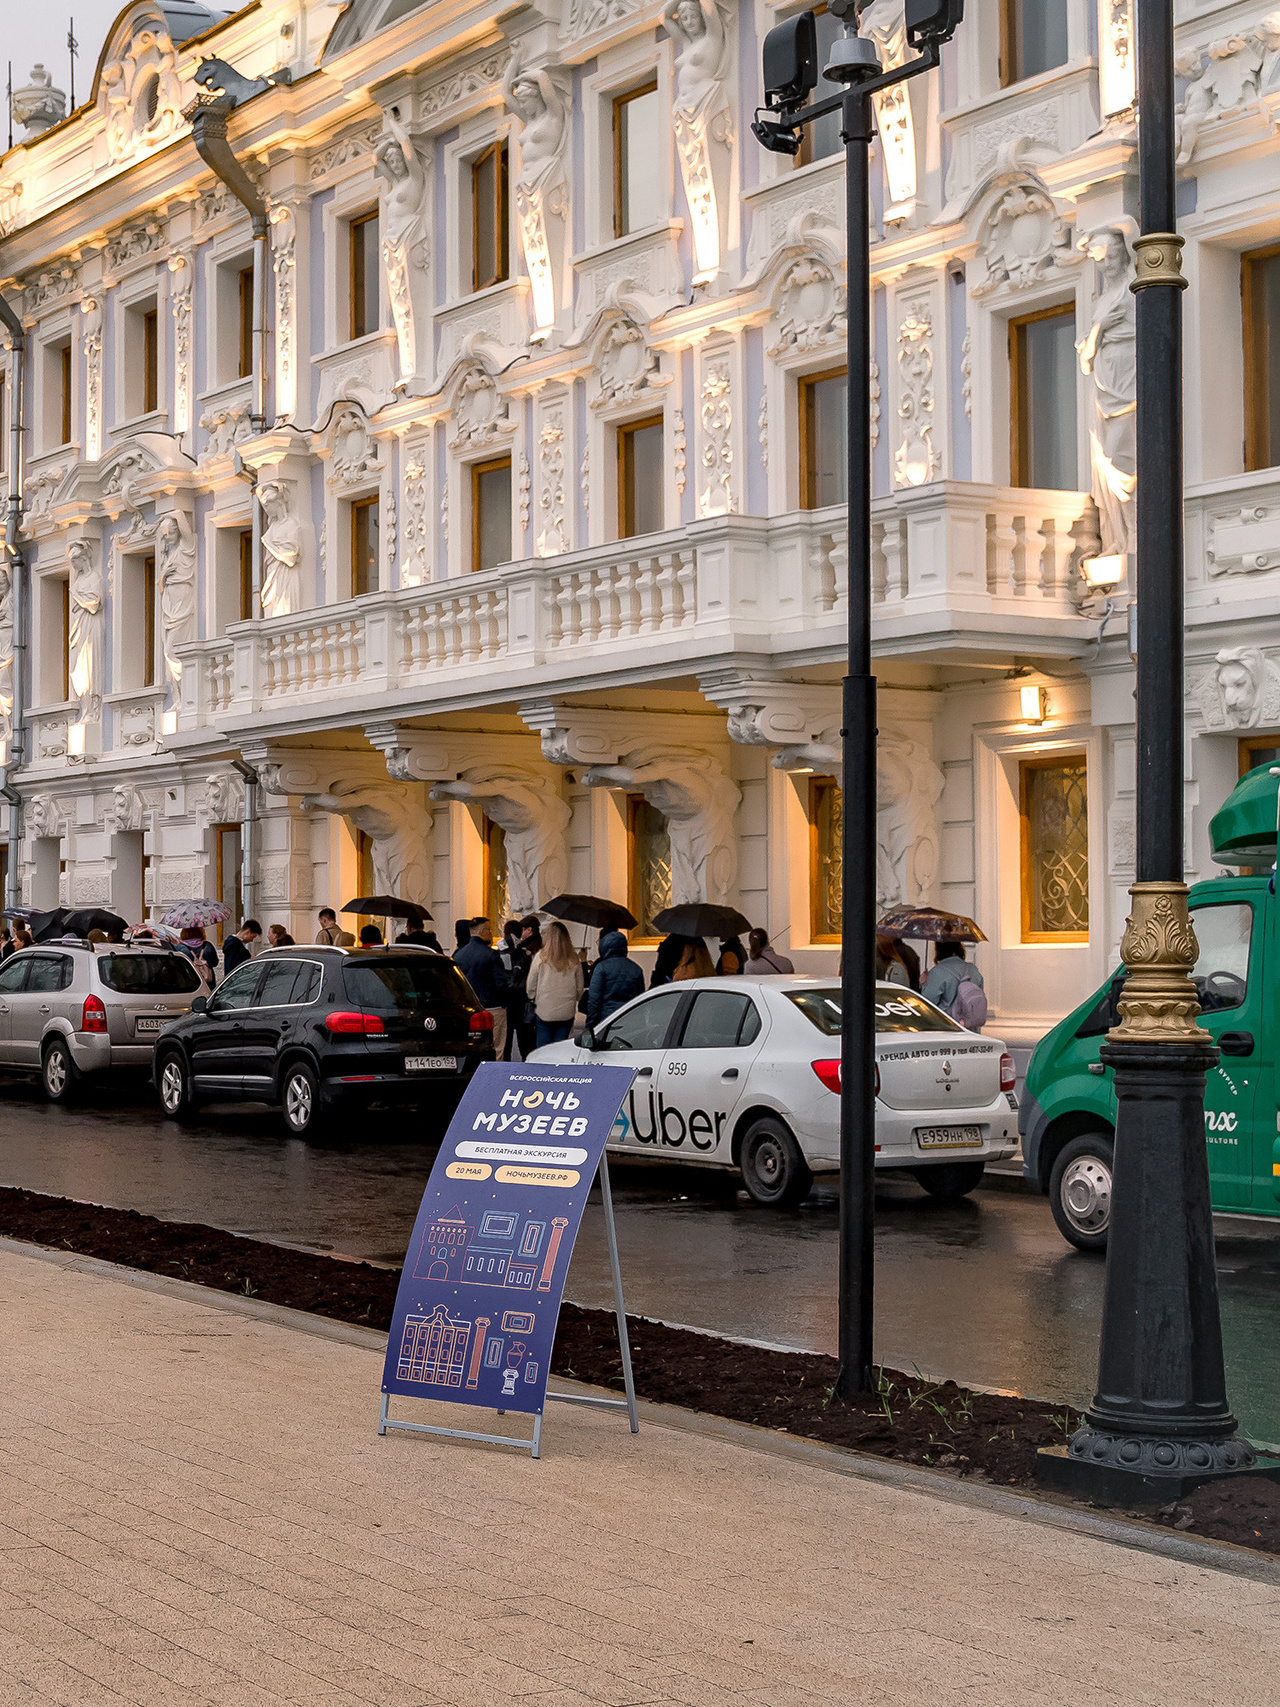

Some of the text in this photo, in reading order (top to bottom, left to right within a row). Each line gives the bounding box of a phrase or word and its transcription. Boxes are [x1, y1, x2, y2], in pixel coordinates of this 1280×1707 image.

[879, 1052, 910, 1063] АРЕНДА
[911, 1049, 930, 1059] АВТО
[939, 1047, 951, 1056] 999
[667, 1061, 688, 1076] 959
[509, 1074, 593, 1085] ВСЕРОССИЙСКАЯ АКЦИЯ
[1218, 1067, 1238, 1096] БУРГЕР
[499, 1088, 581, 1111] НОЧЬ
[472, 1112, 589, 1137] МУЗЕЕВ
[629, 1089, 727, 1150] Uber
[474, 1146, 568, 1159] БЕСПЛАТНАЯ ЭКСКУРСИЯ
[465, 1167, 482, 1175] МАЯ
[506, 1170, 569, 1181] НОЧЬМУЗЕЕВ.РФ
